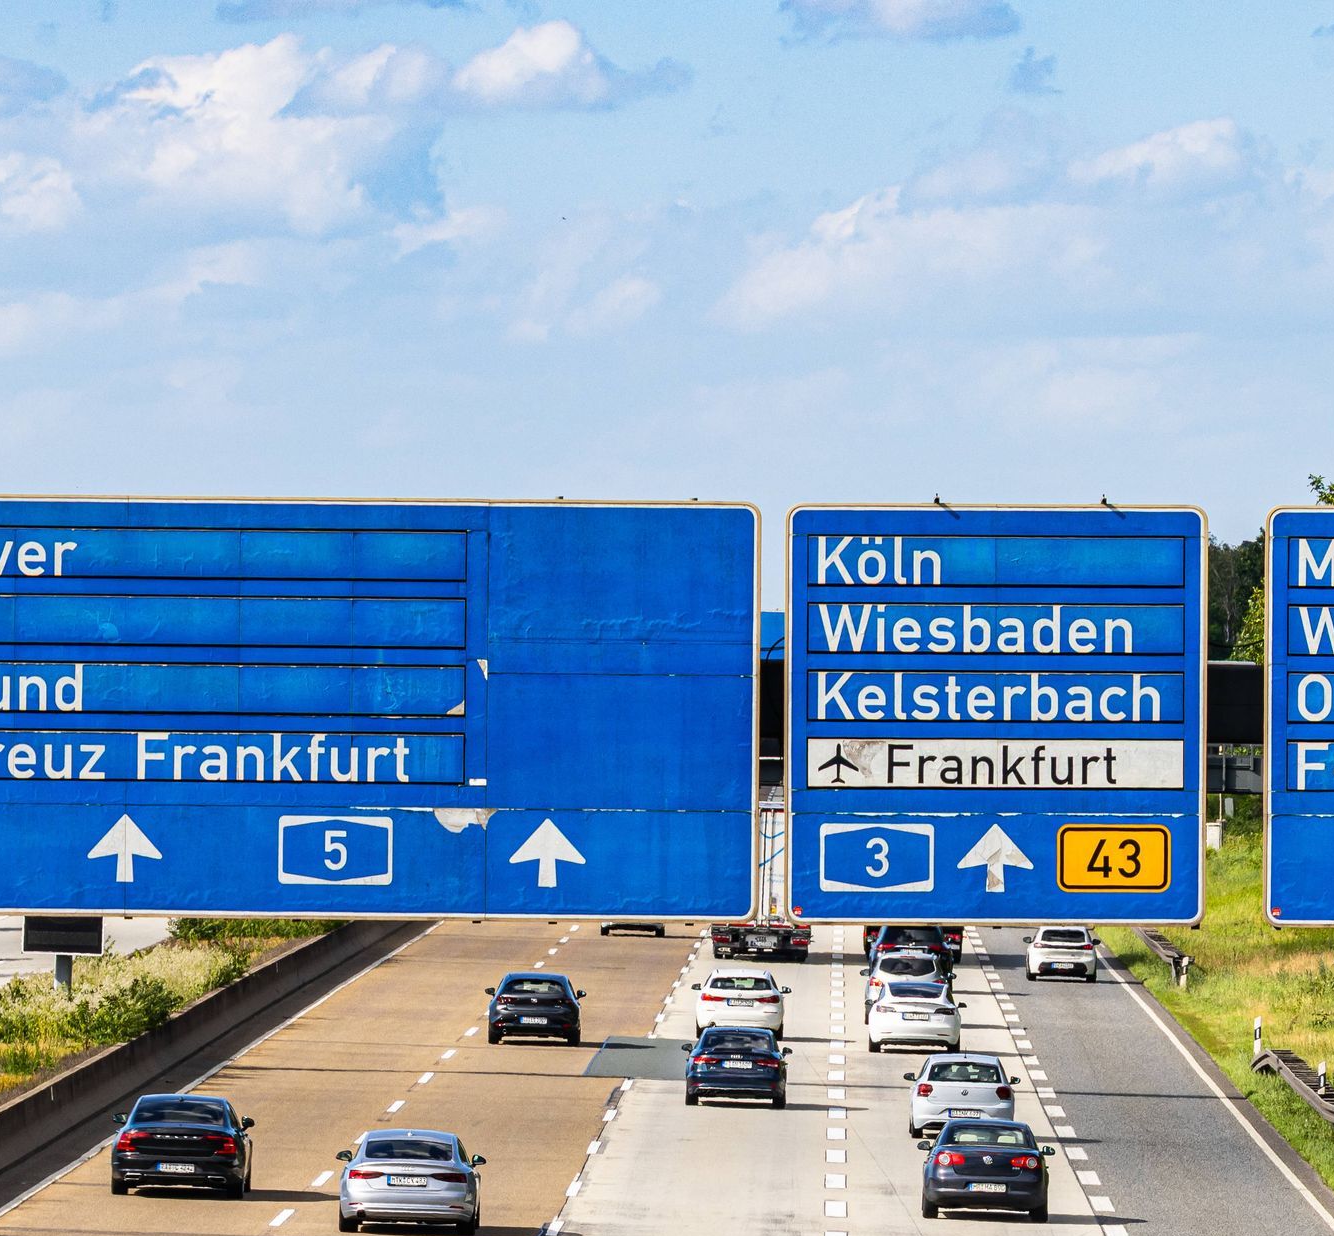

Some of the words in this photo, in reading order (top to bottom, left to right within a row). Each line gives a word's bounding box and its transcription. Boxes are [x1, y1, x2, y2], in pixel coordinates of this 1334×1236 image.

[817, 536, 942, 586] Köln
[817, 604, 1134, 654] Wiesbaden
[816, 672, 1162, 722] Kelsterbach
[135, 732, 410, 783] Frankfurt
[886, 743, 1118, 786] Frankfurt
[322, 830, 349, 871] 5
[865, 837, 891, 878] 3
[1086, 838, 1143, 879] 43
